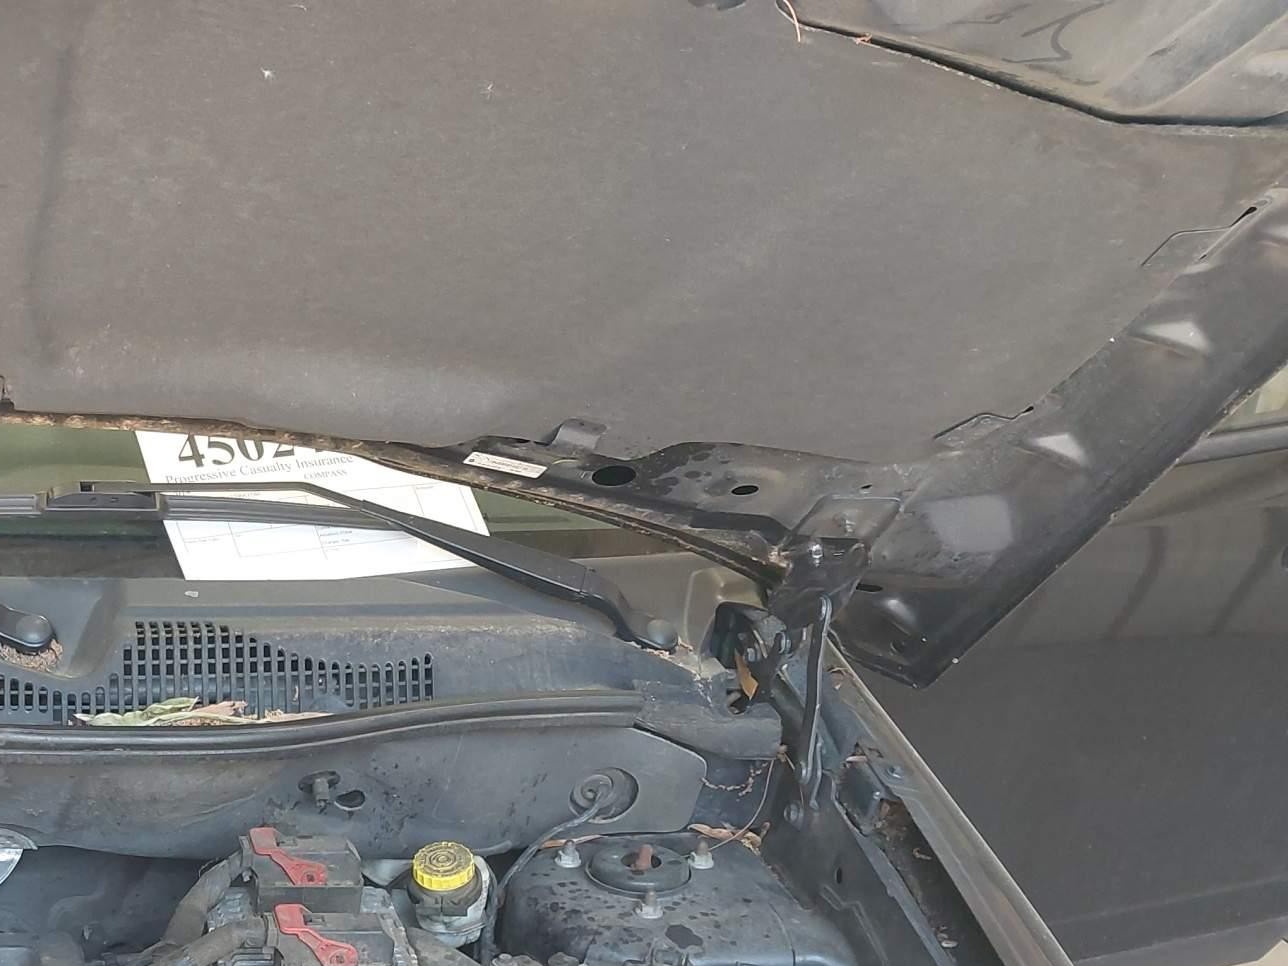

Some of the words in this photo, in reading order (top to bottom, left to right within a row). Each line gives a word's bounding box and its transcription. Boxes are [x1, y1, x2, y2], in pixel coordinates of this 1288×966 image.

[178, 432, 324, 468] 4502
[165, 467, 237, 484] Progressive
[240, 460, 292, 476] Casualty
[295, 454, 354, 470] Insurance
[304, 469, 349, 481] COMPASS
